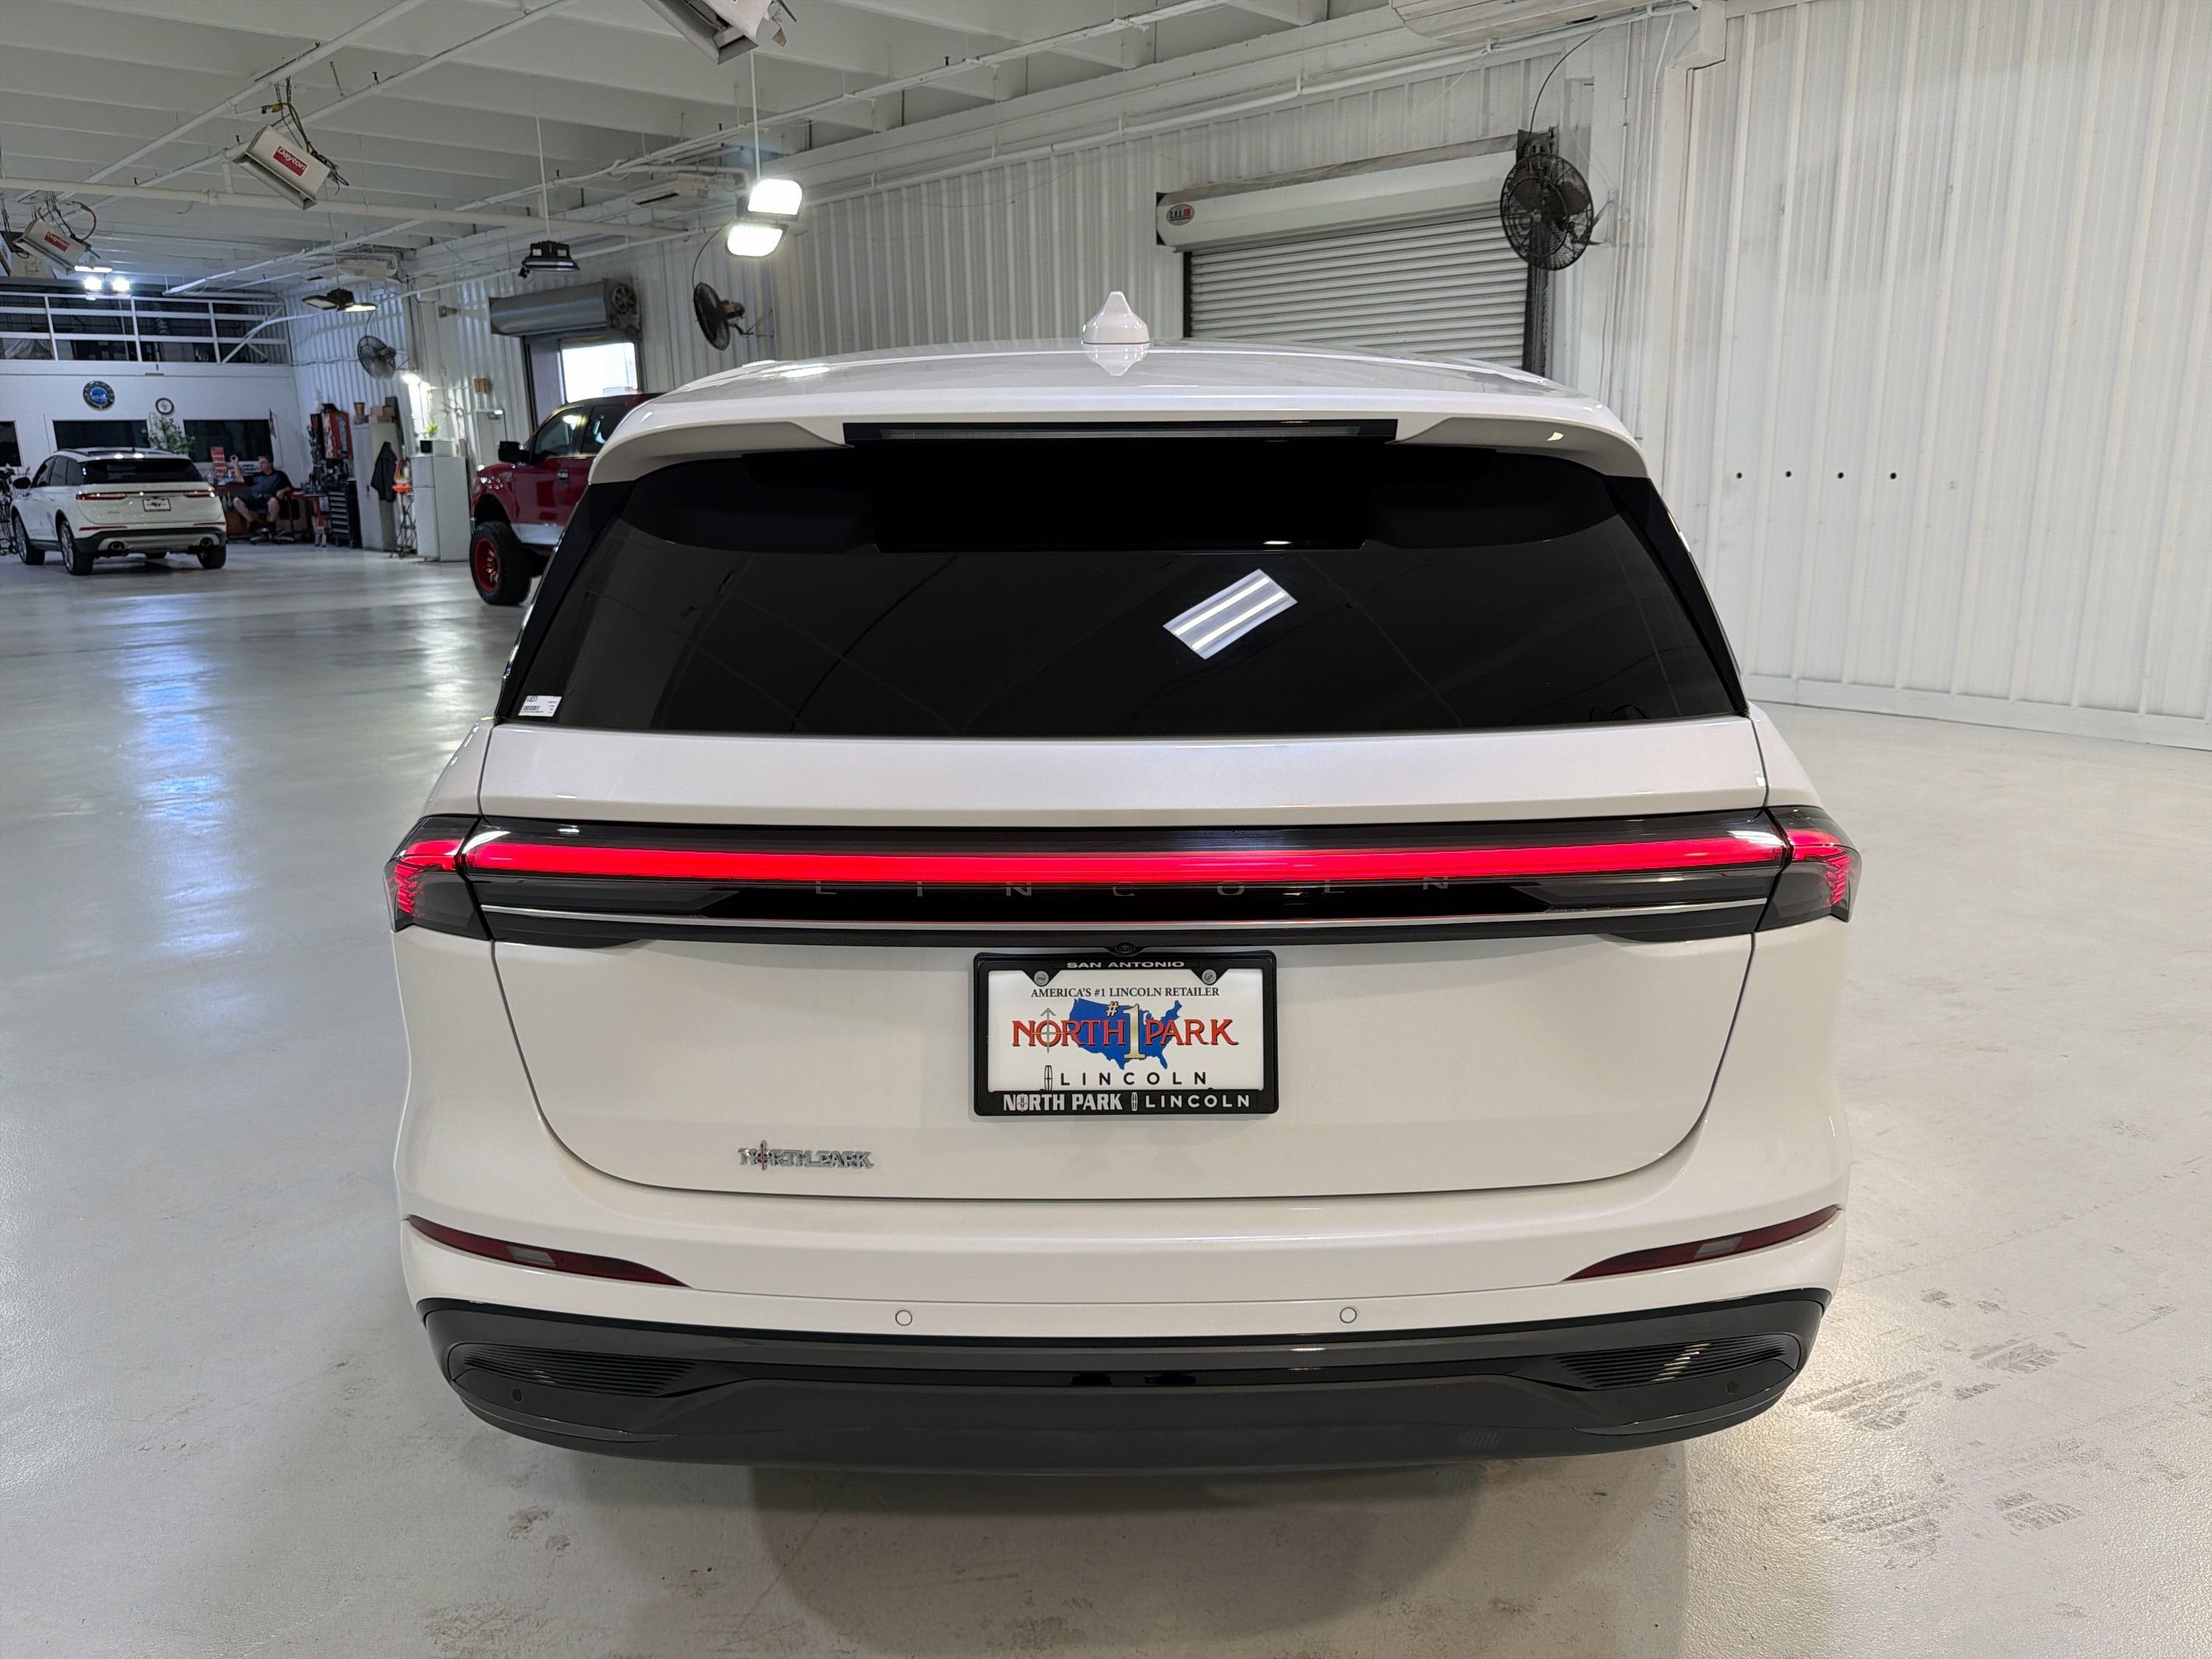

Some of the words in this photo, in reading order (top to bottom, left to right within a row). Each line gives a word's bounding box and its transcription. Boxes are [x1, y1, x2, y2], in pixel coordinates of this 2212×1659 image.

[277, 147, 306, 170] Dayton
[815, 877, 1448, 897] LINCOLN
[1031, 988, 1091, 998] AMERICA'S
[1094, 988, 1105, 997] #1
[1109, 987, 1162, 997] LINCOLN
[1165, 987, 1220, 997] RETAILER
[1012, 1019, 1125, 1047] NORTH
[1144, 1018, 1239, 1046] PARK
[1060, 1072, 1206, 1086] LINCOLN
[1004, 1093, 1065, 1112] NORTH
[1071, 1093, 1123, 1110] PARK
[1145, 1094, 1250, 1107] LINCOLN
